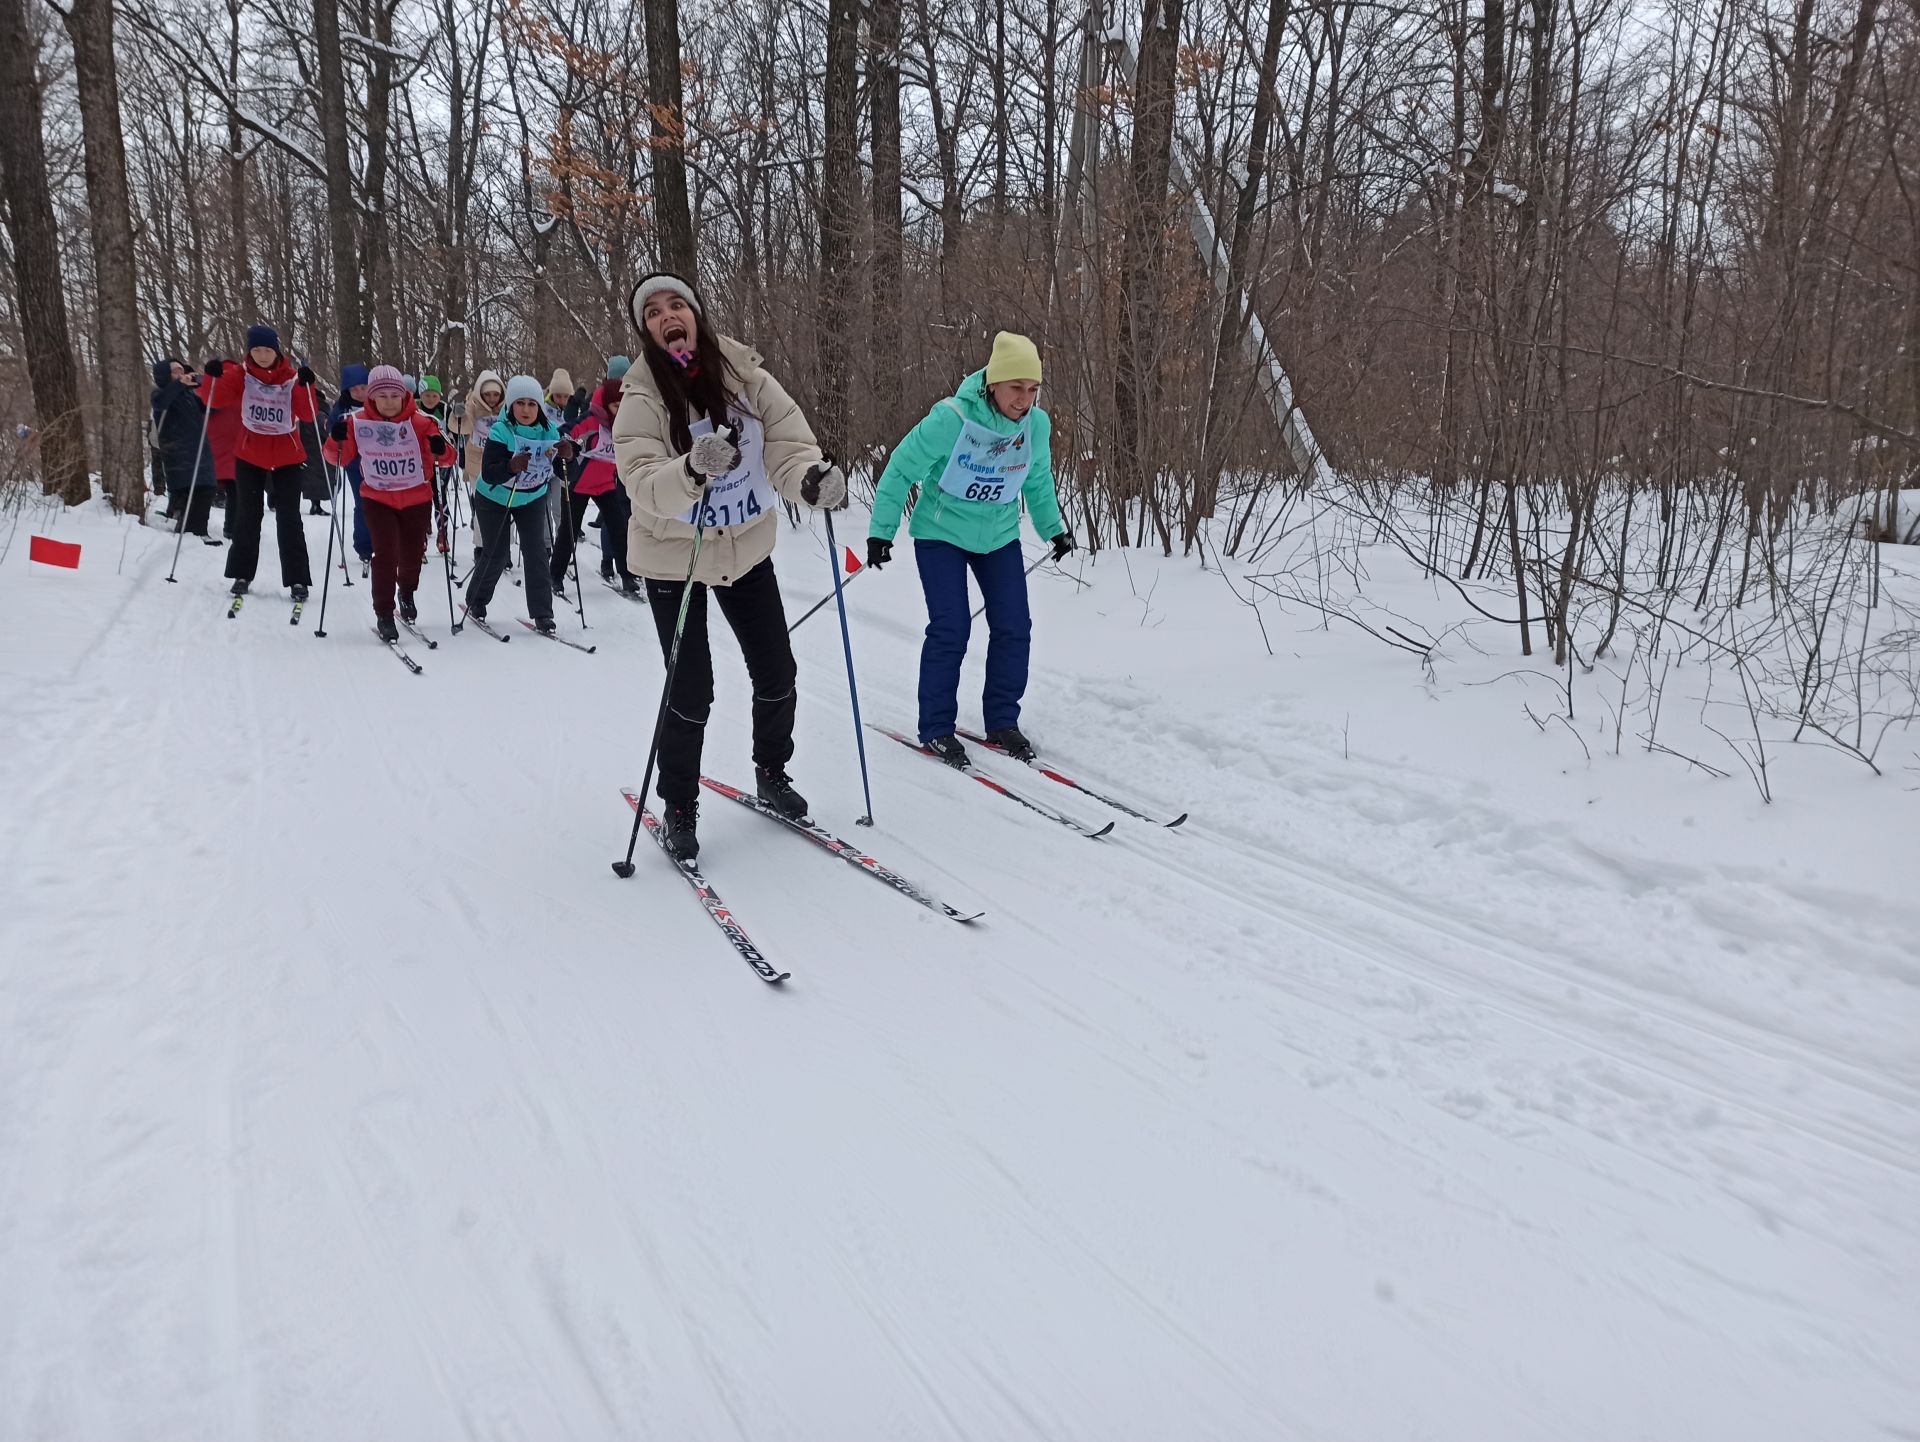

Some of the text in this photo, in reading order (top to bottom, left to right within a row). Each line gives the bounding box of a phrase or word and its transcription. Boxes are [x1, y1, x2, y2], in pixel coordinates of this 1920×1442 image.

[249, 404, 284, 423] 19050
[372, 458, 416, 476] 19075
[1007, 463, 1027, 472] TOYOTA
[965, 483, 1005, 502] 685
